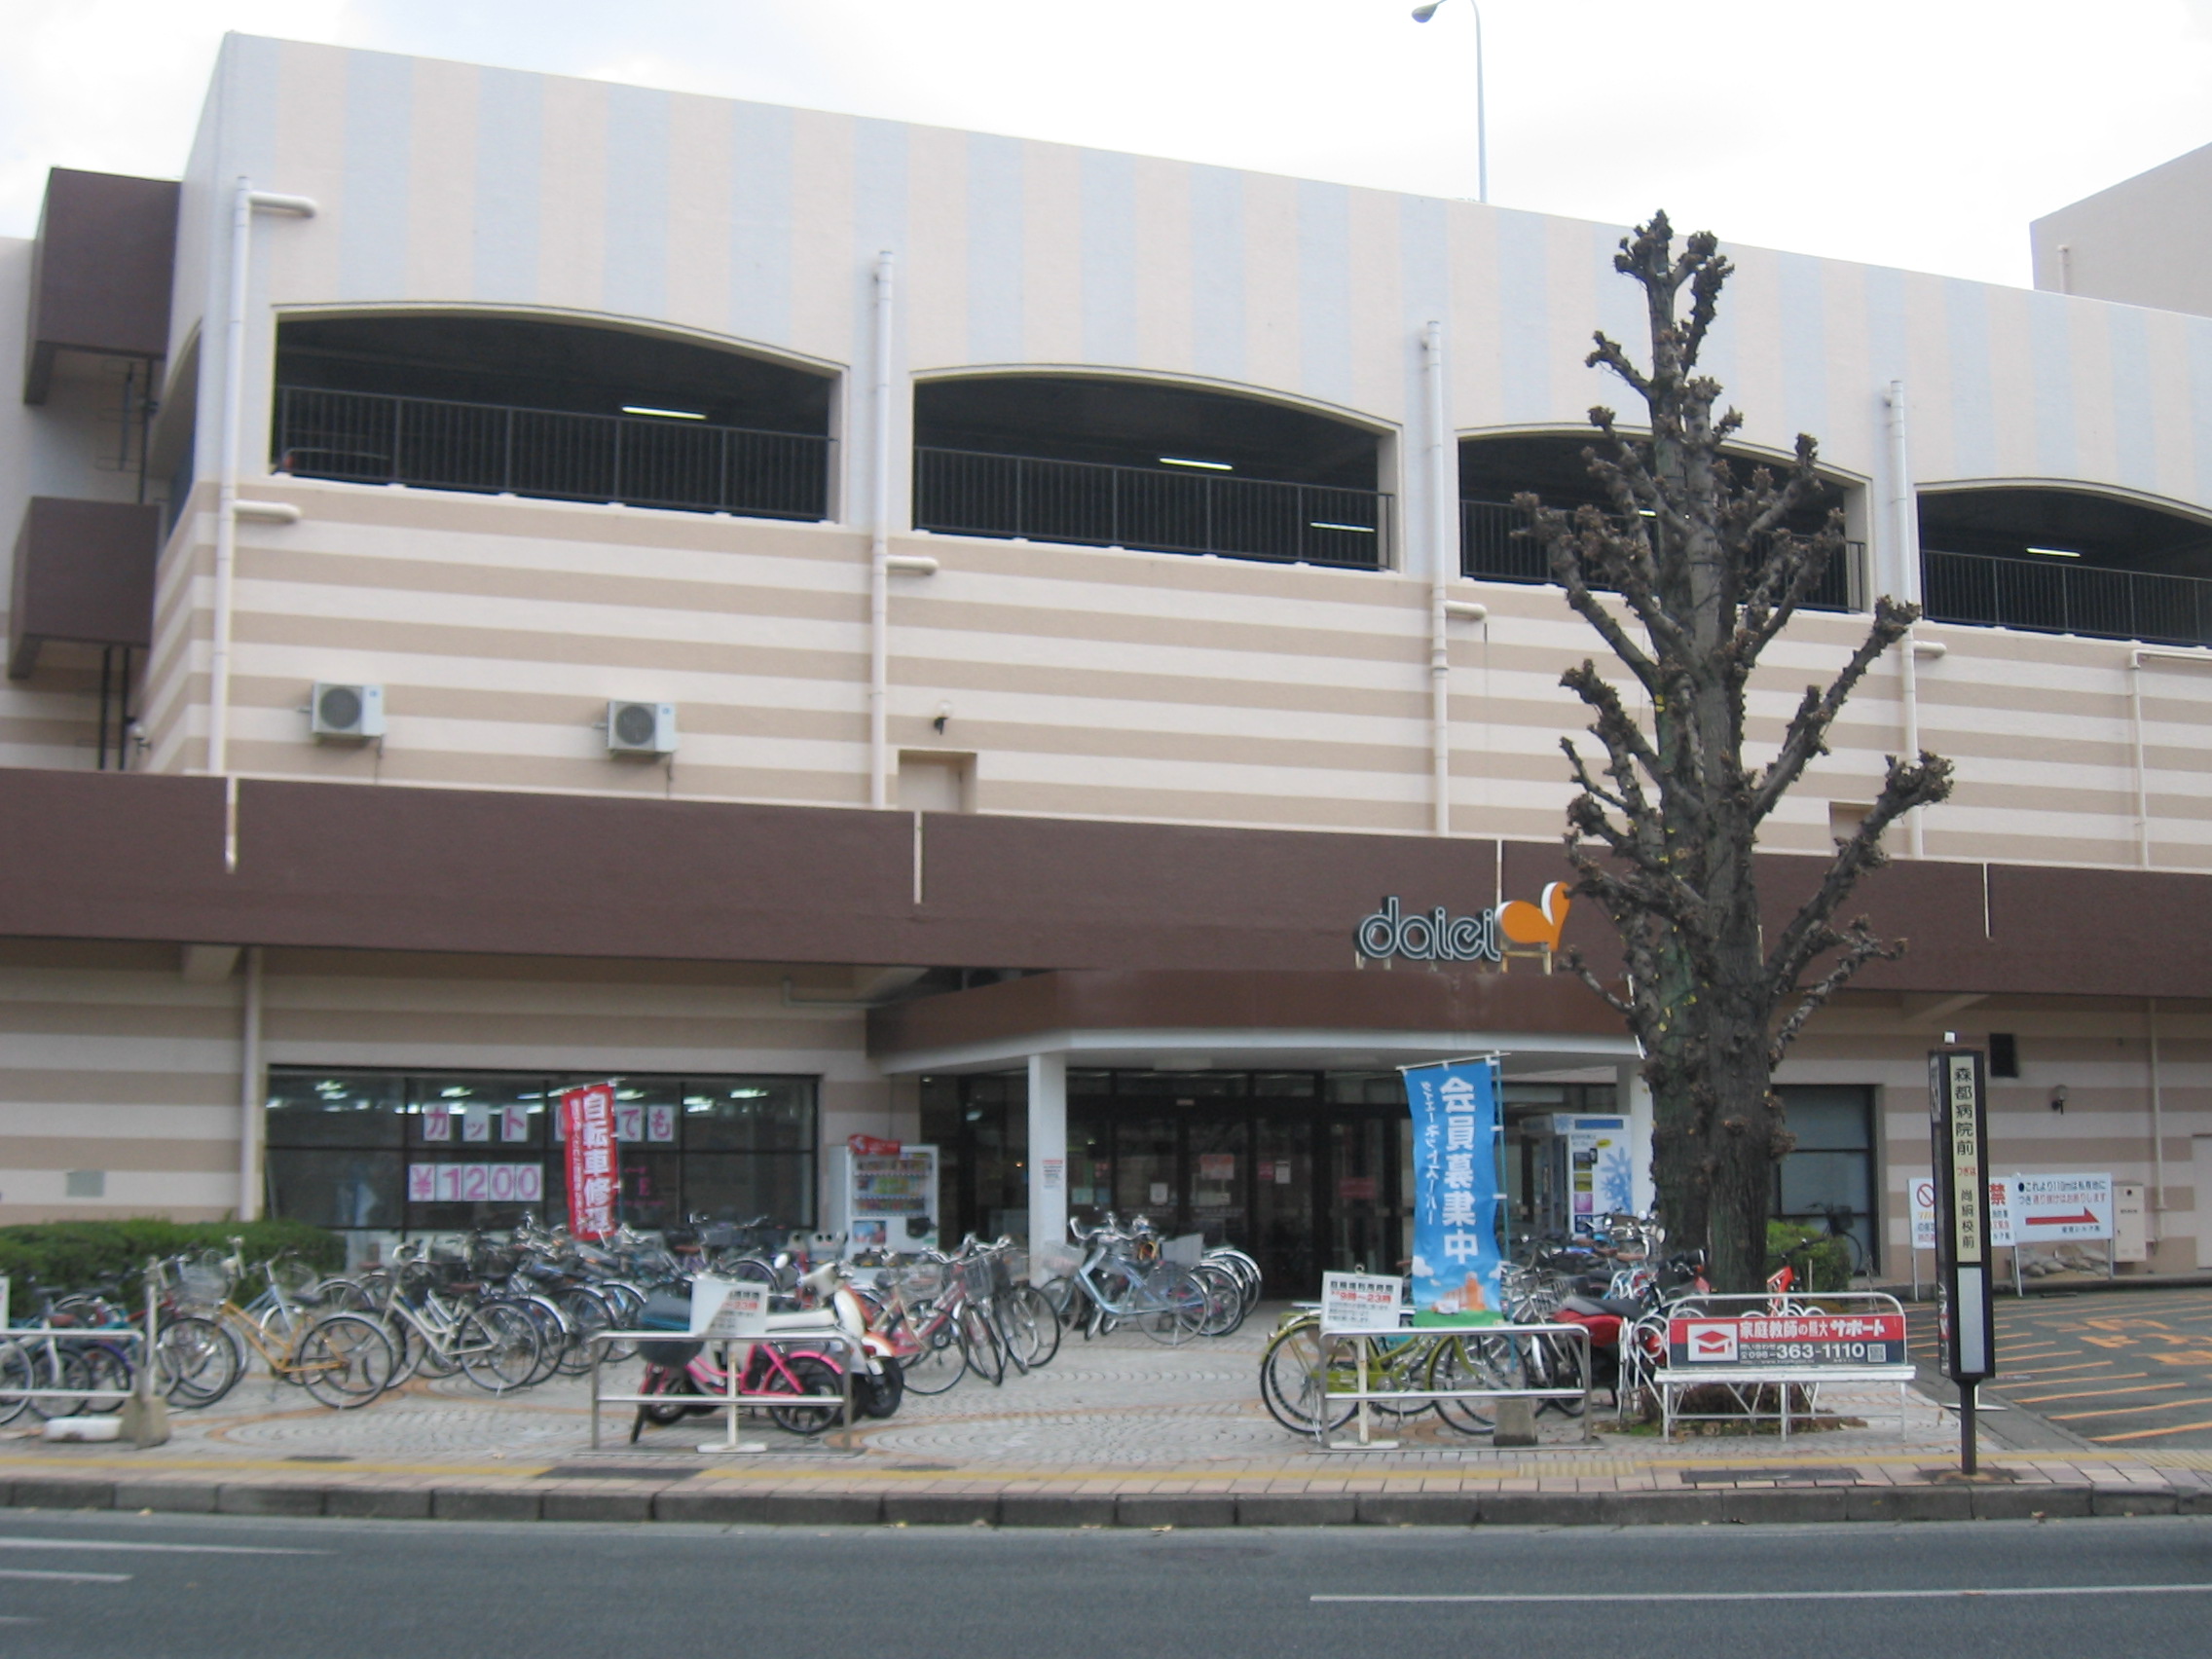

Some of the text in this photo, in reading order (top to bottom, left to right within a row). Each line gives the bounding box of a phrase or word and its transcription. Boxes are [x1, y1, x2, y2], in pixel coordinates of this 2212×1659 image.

[1354, 895, 1501, 962] daiei
[426, 1106, 527, 1140] カット
[1953, 1066, 1974, 1156] 森都病院前
[412, 1166, 540, 1198] ¥1200
[1420, 1081, 1440, 1225] ダイエーネットスーパー
[1439, 1076, 1479, 1265] 会員募集中
